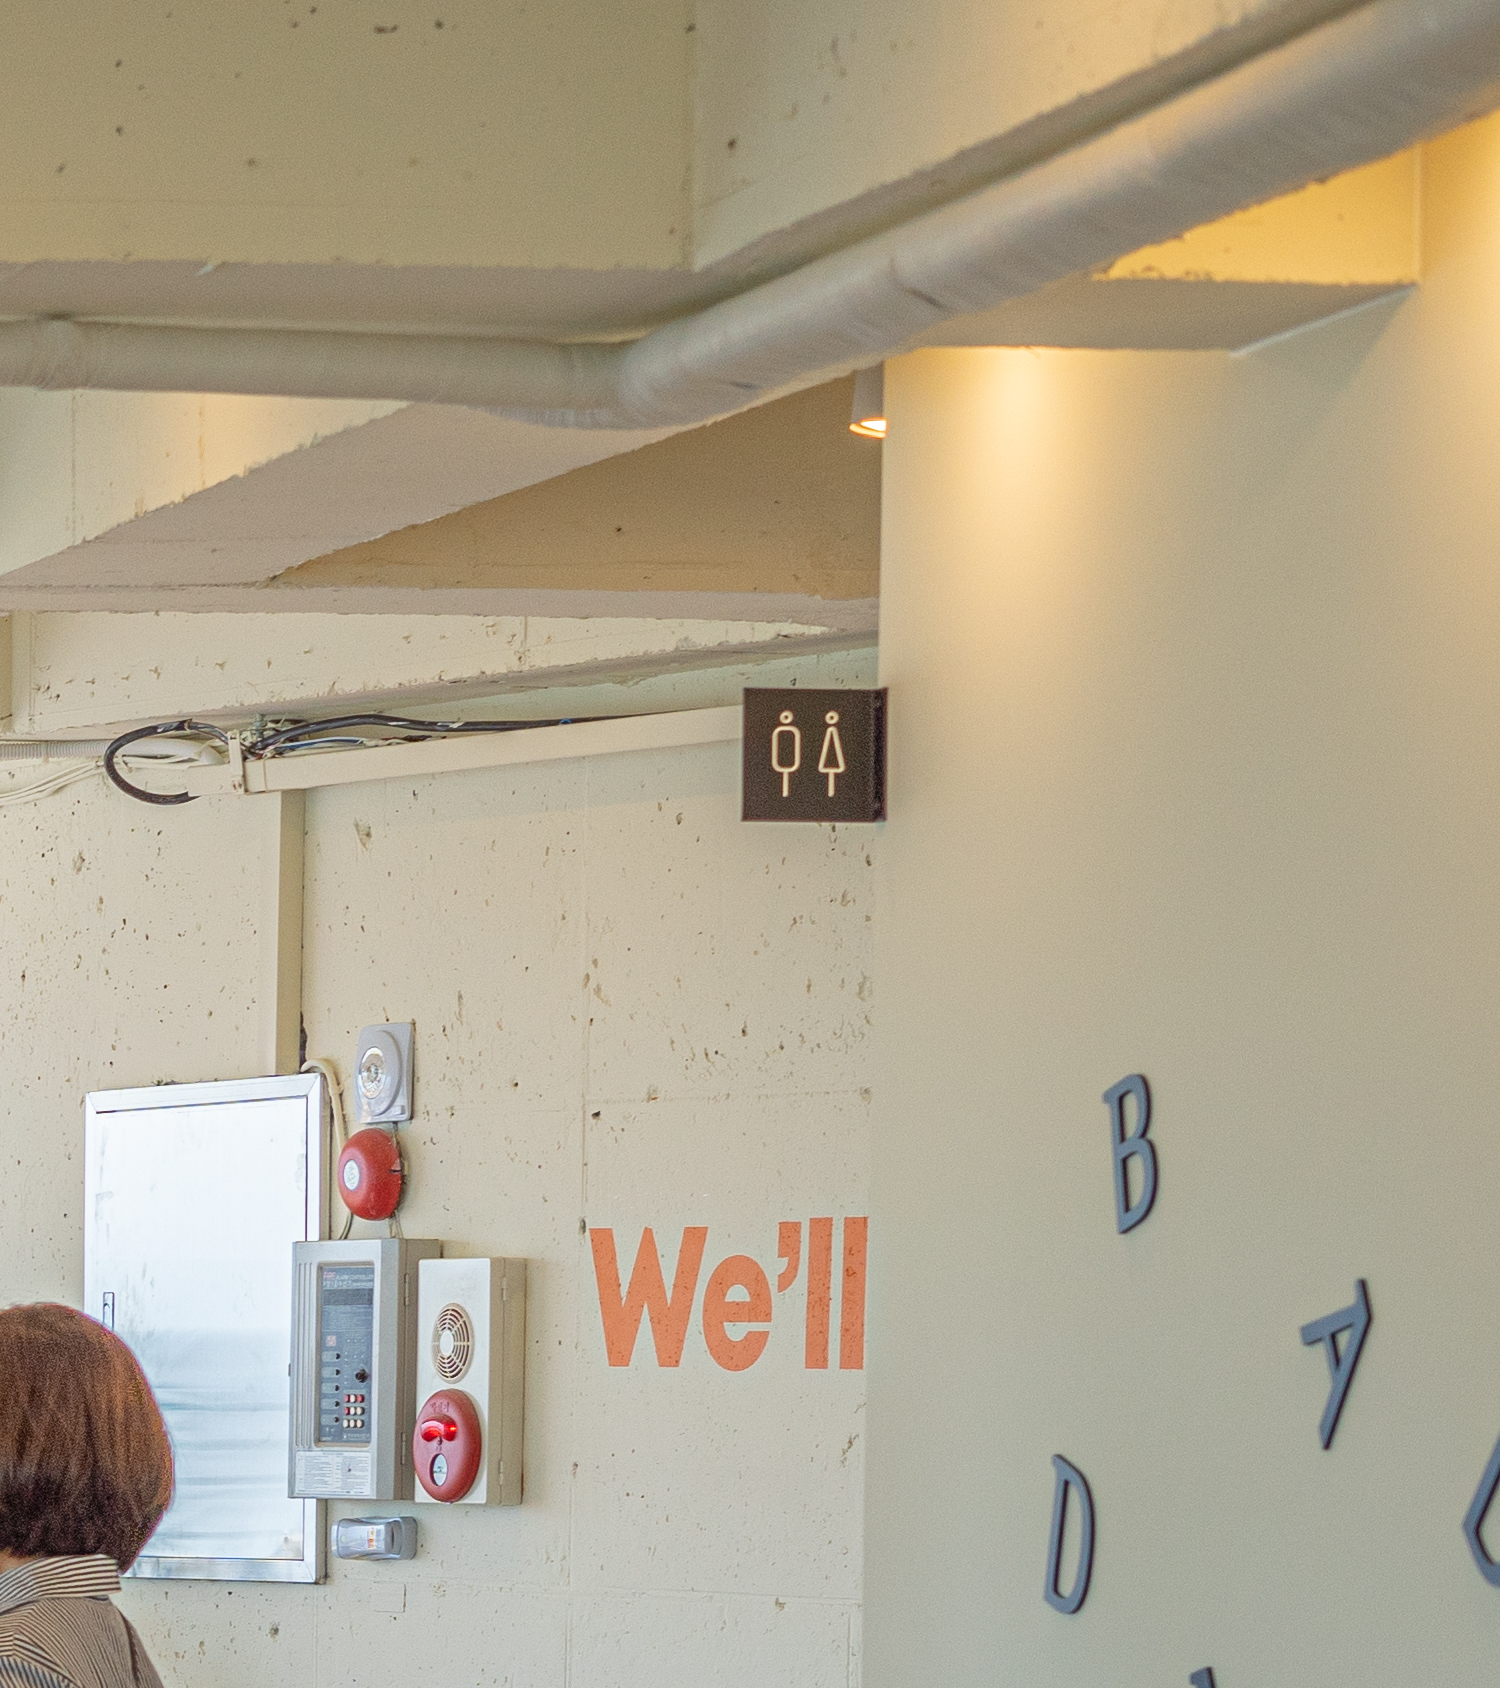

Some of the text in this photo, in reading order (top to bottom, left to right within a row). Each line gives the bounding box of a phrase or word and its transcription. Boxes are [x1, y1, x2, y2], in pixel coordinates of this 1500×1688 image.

[1102, 1073, 1159, 1235] B
[589, 1216, 869, 1372] We'll
[1042, 1453, 1096, 1615] D
